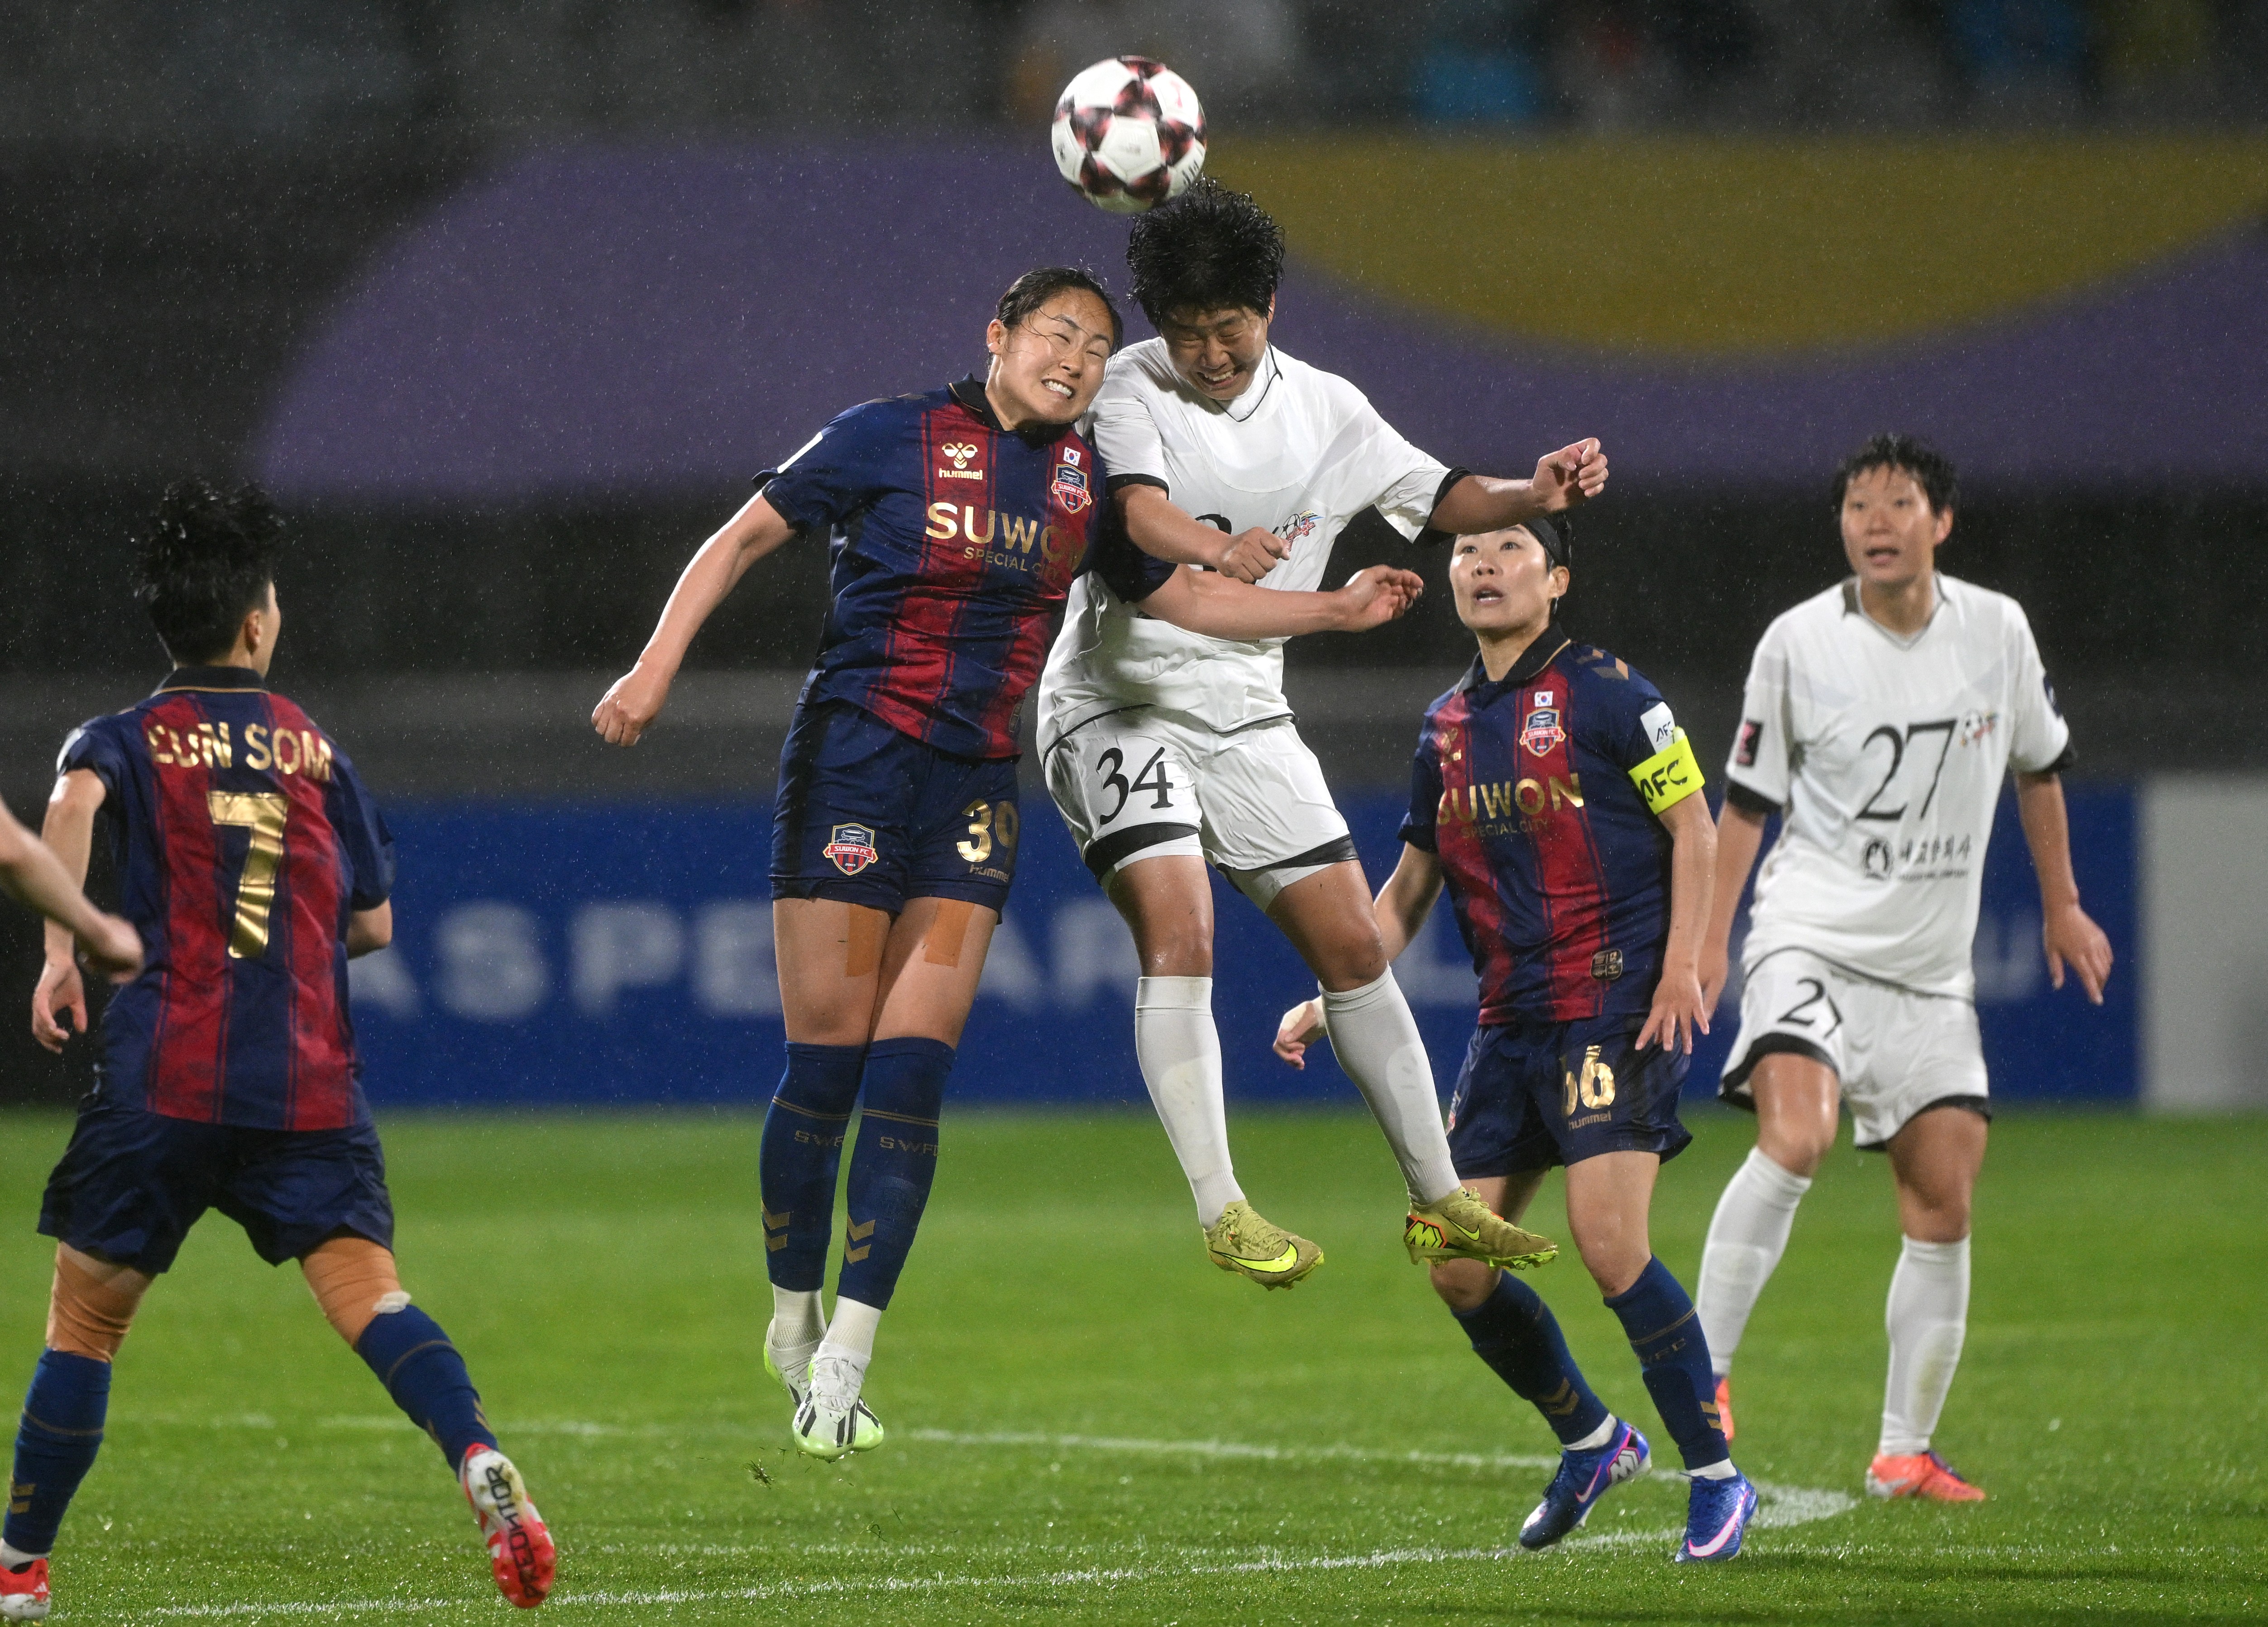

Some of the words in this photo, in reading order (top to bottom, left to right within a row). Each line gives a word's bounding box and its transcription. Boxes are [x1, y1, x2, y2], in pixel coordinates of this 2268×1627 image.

[939, 468, 983, 480] hummel
[1058, 484, 1076, 492] SUWON
[963, 546, 1028, 572] SPECIAL
[148, 721, 232, 769] EUN
[245, 723, 332, 782] SOM
[1855, 718, 1959, 821] 27
[1097, 746, 1174, 825] 34
[1640, 759, 1688, 802] AFC
[957, 798, 1019, 868] 39
[206, 791, 290, 958] 7
[1568, 1111, 1612, 1131] hummel
